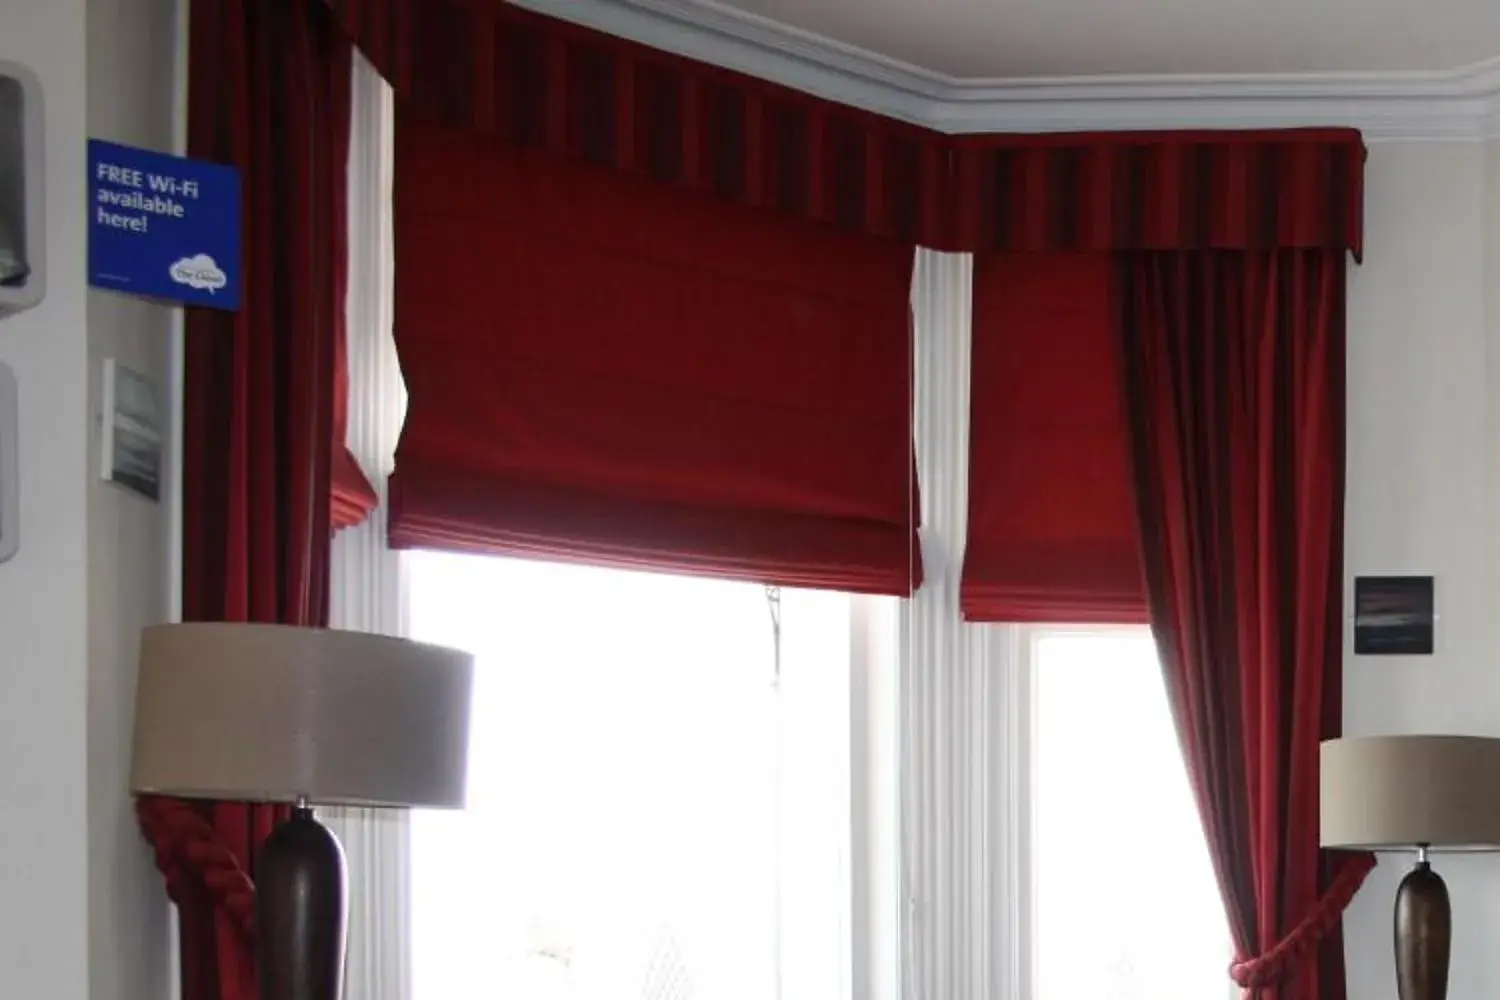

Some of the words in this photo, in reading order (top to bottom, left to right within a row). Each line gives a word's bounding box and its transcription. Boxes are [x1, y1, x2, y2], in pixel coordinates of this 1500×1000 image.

[97, 164, 143, 188] FREE
[148, 174, 199, 199] Wi-Fi
[97, 189, 185, 217] available
[97, 208, 148, 233] here!
